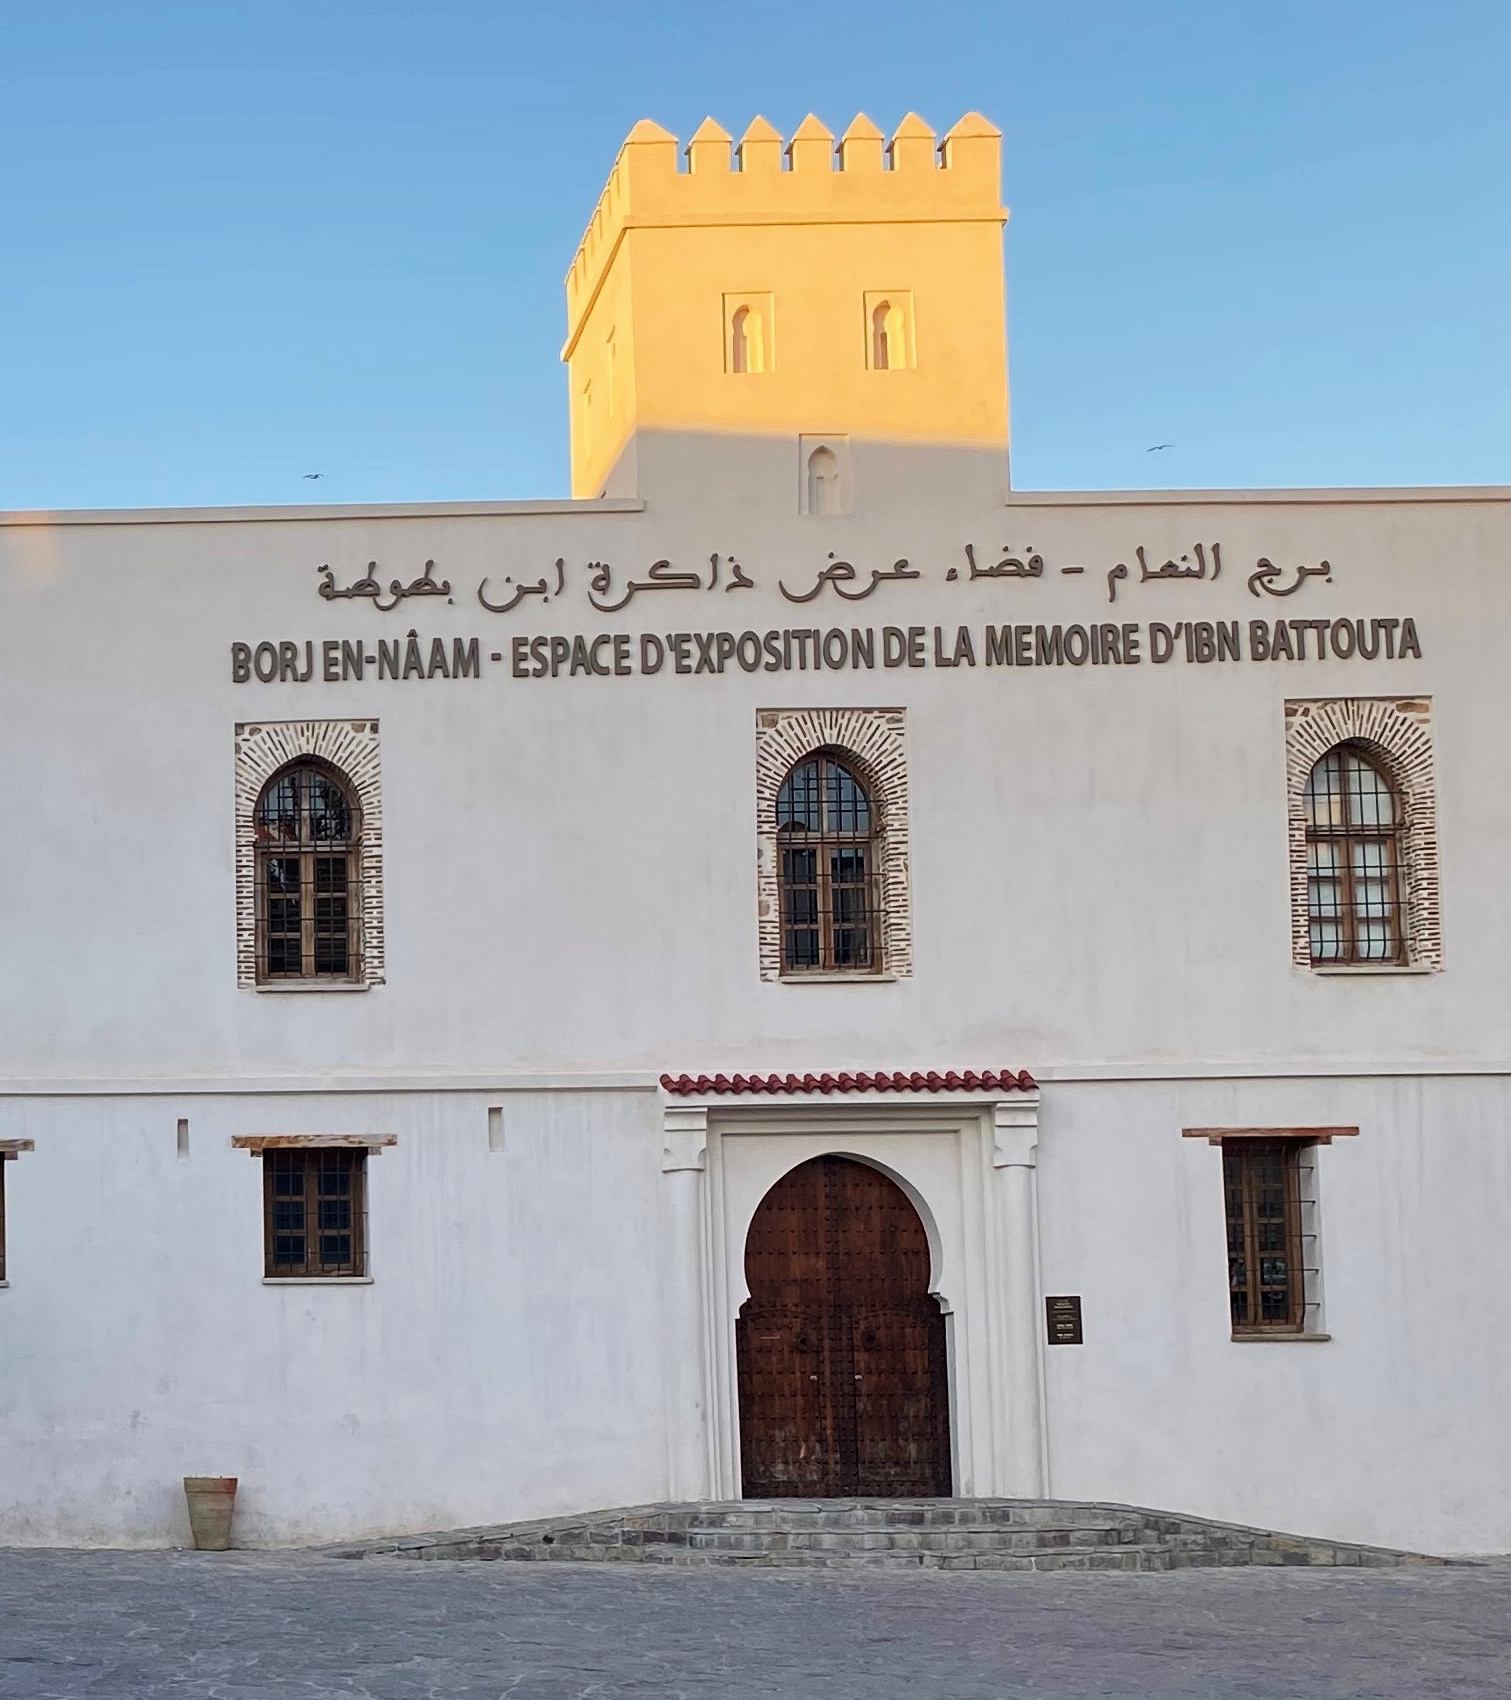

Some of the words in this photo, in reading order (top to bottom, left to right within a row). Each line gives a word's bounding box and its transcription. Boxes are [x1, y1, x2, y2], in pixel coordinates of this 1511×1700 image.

[316, 559, 455, 612] بطوطة
[477, 557, 566, 613] ابن
[587, 552, 755, 613] ذاكرة
[779, 551, 921, 604] عرض
[945, 544, 1044, 583] فضاء
[1107, 543, 1222, 603] النعام
[1248, 557, 1333, 599] برج
[231, 640, 314, 684] BORJ
[322, 628, 481, 682] EN-NÂAM
[511, 633, 633, 678] ESPACE
[639, 627, 875, 676] D'EXPOSITION
[881, 626, 927, 669] DE
[933, 625, 977, 668] LA
[985, 622, 1141, 669] MEMOIRE
[1148, 620, 1242, 665] D'IBN
[1248, 617, 1423, 662] BATTOUTA
